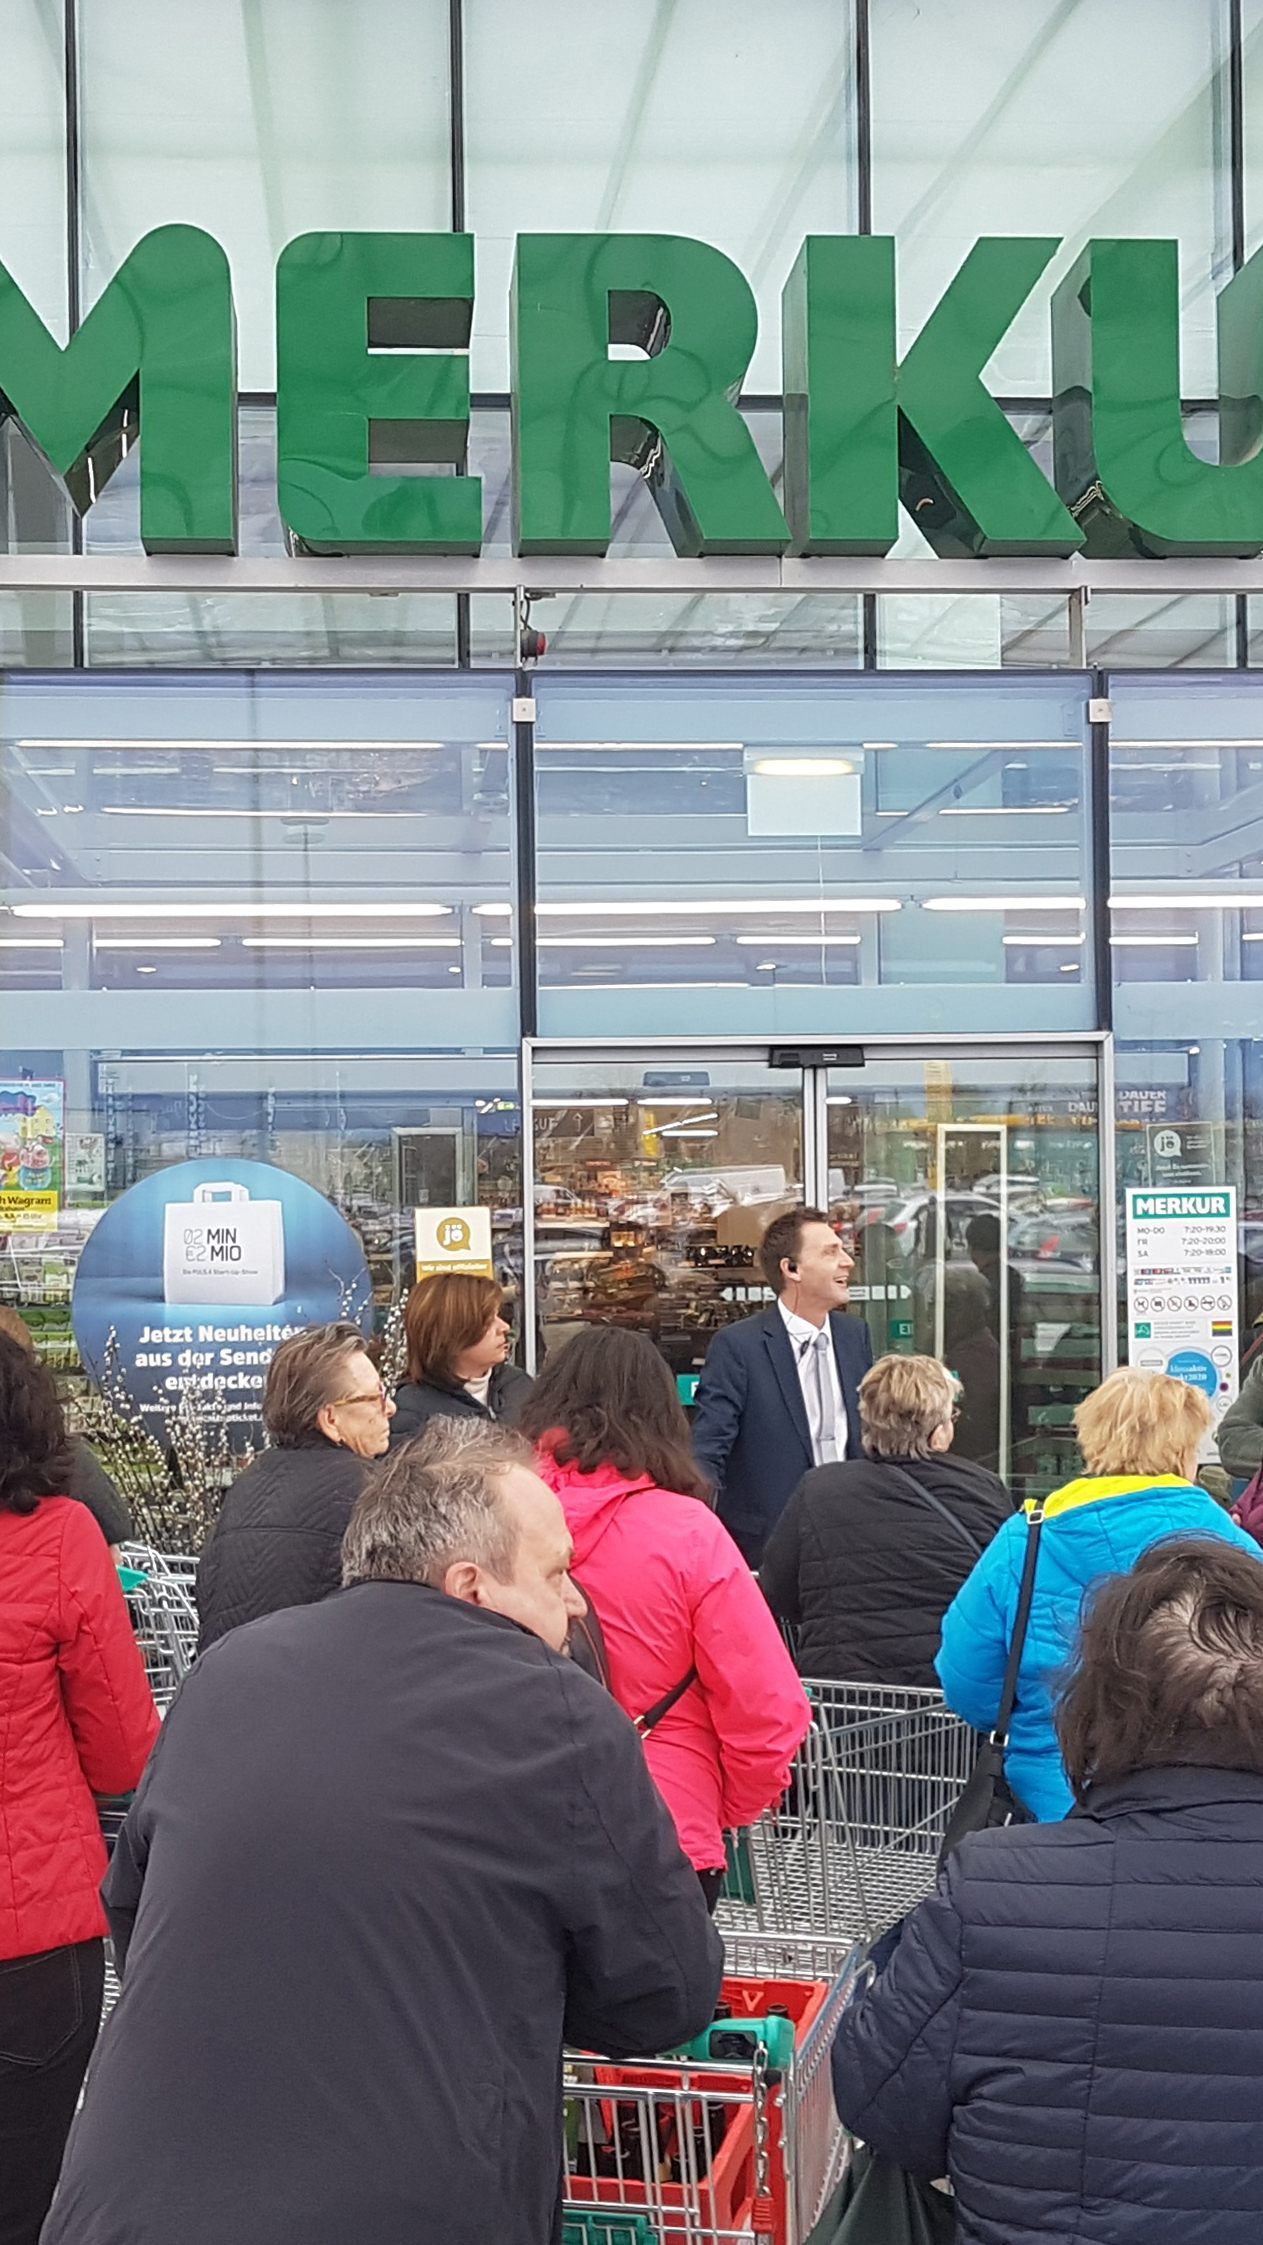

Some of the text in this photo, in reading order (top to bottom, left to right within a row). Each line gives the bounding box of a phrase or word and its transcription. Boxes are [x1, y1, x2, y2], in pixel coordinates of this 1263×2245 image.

[8, 1196, 52, 1208] Wagram
[1136, 1196, 1226, 1216] MERKUR
[206, 1227, 237, 1245] MIN
[210, 1245, 242, 1262] MIO
[1138, 1250, 1150, 1258] SA
[138, 1325, 194, 1344] Jetzt
[134, 1347, 274, 1368] aus der Send
[164, 1371, 268, 1391] entdecke
